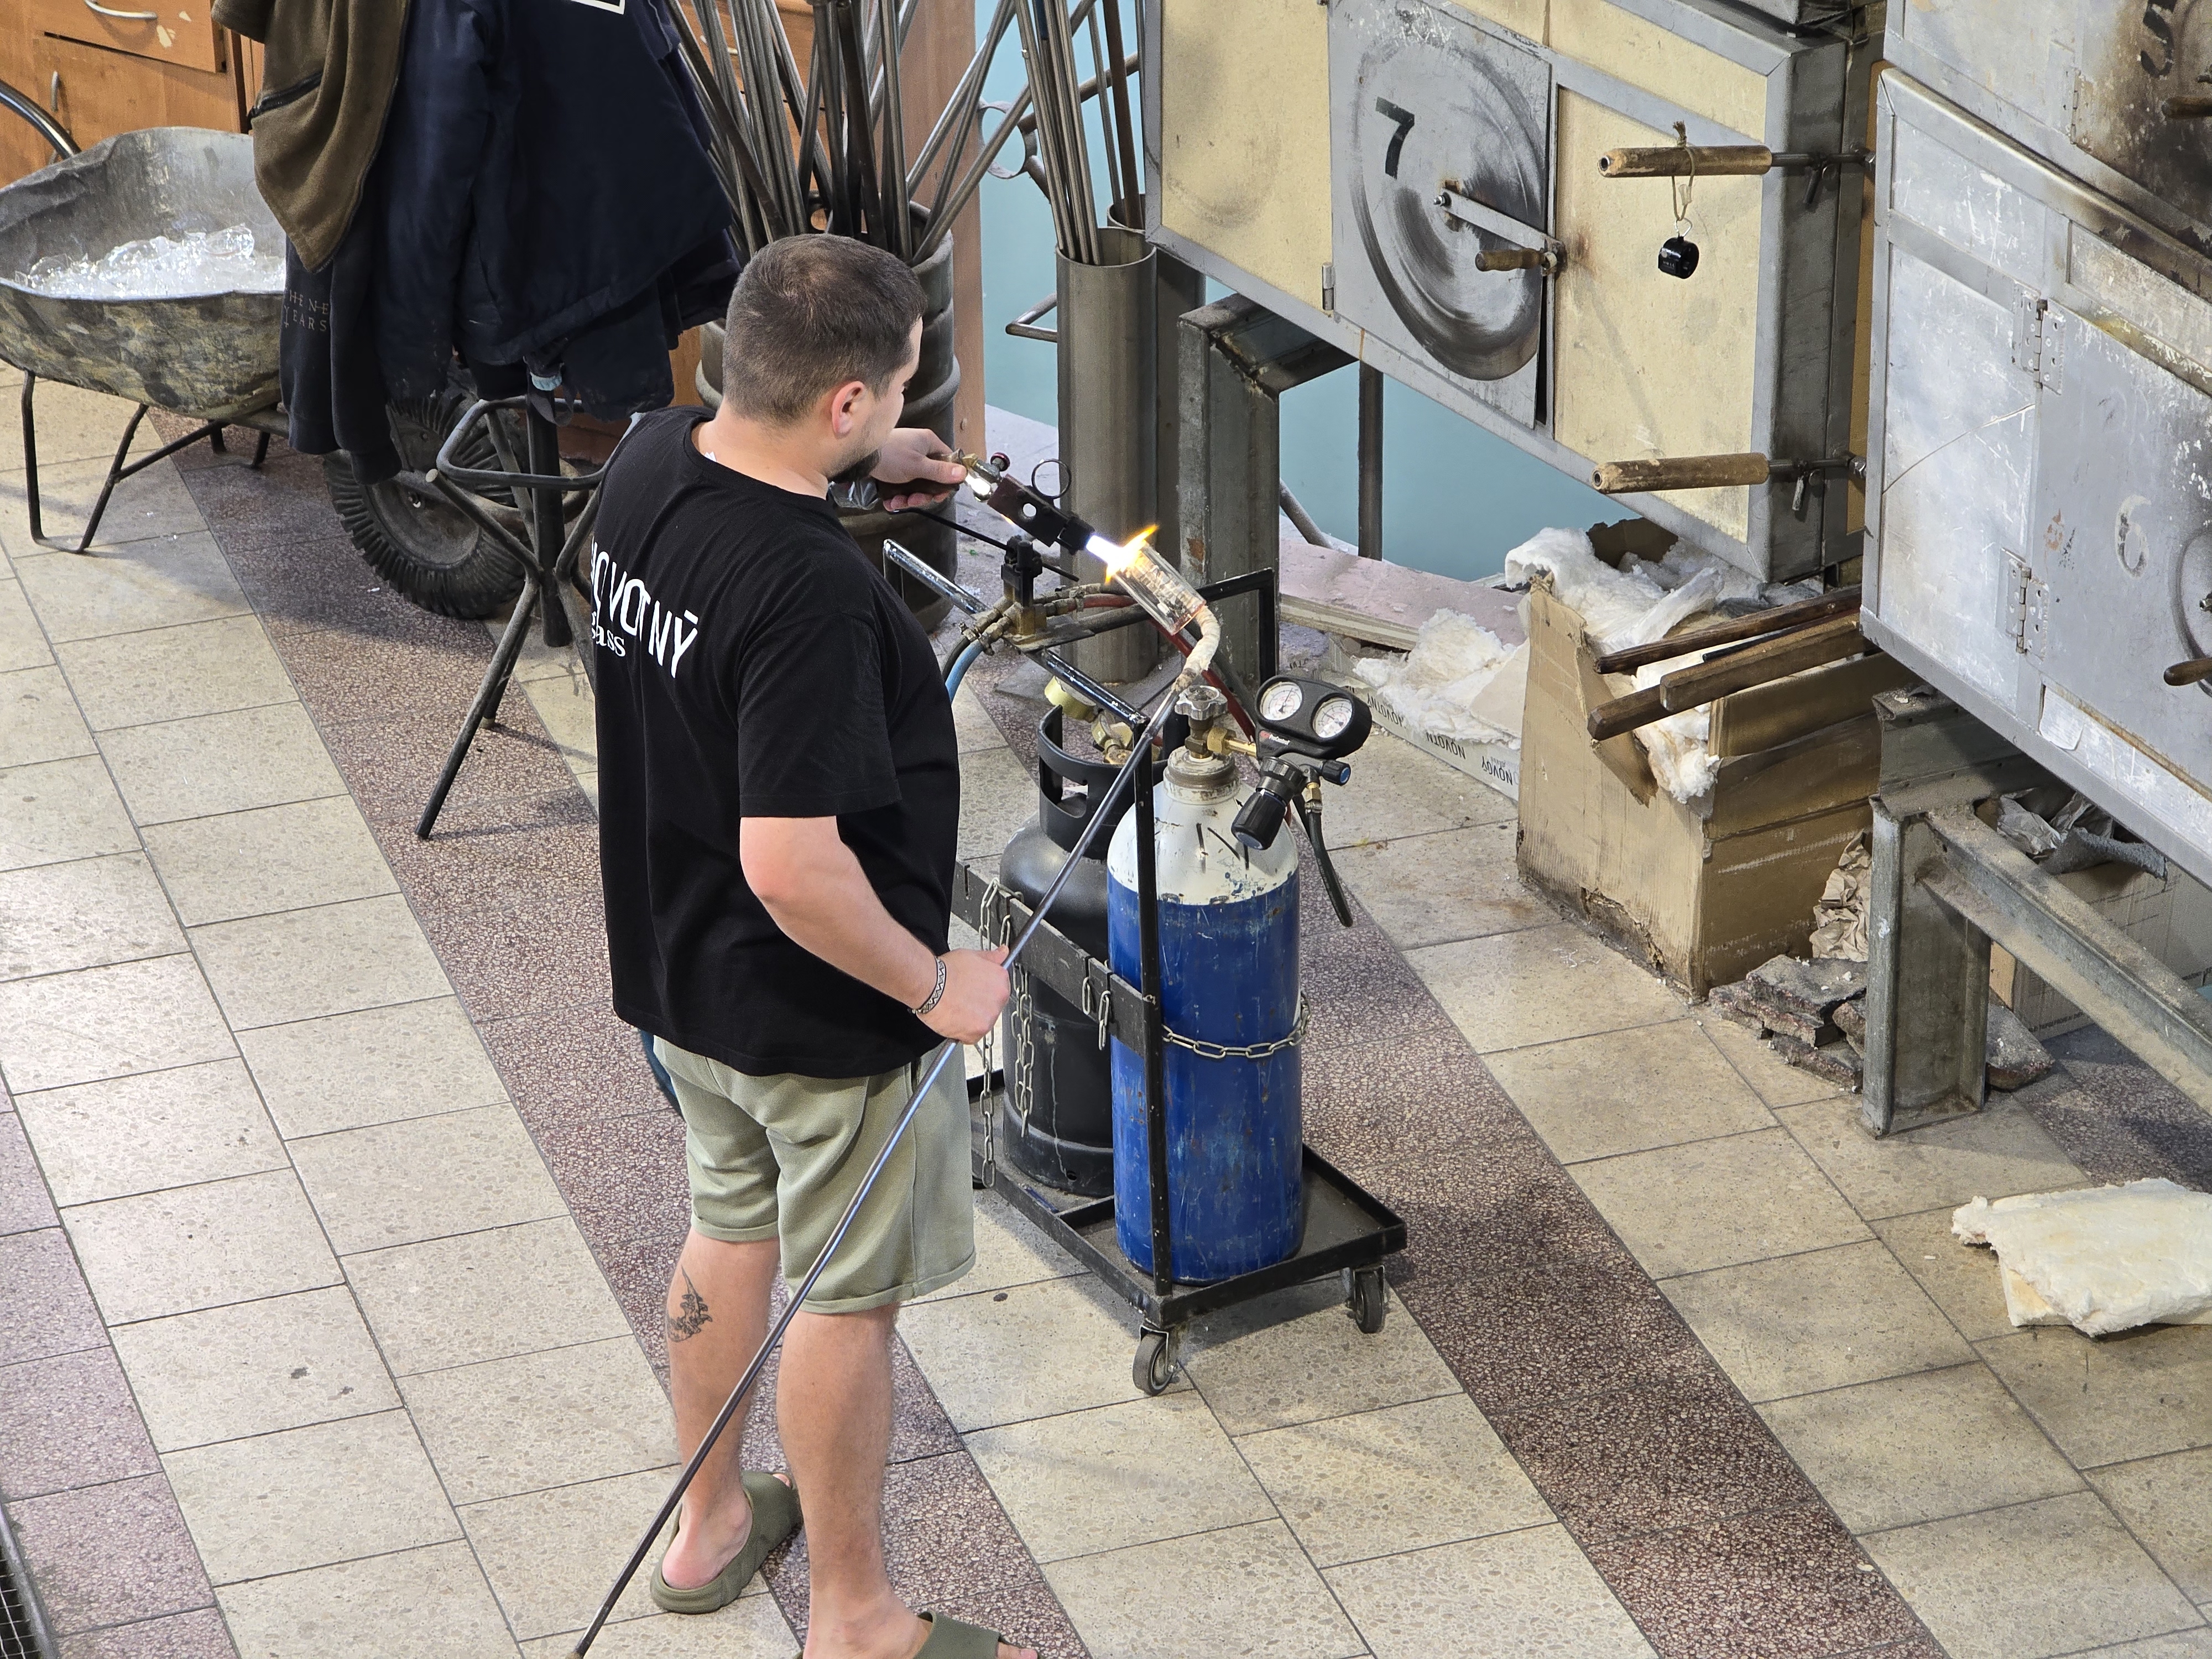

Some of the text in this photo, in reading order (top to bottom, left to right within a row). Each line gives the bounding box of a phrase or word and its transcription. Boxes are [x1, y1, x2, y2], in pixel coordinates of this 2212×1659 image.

[1375, 96, 1415, 180] 7
[284, 305, 327, 331] YEARS
[2115, 494, 2152, 580] 6
